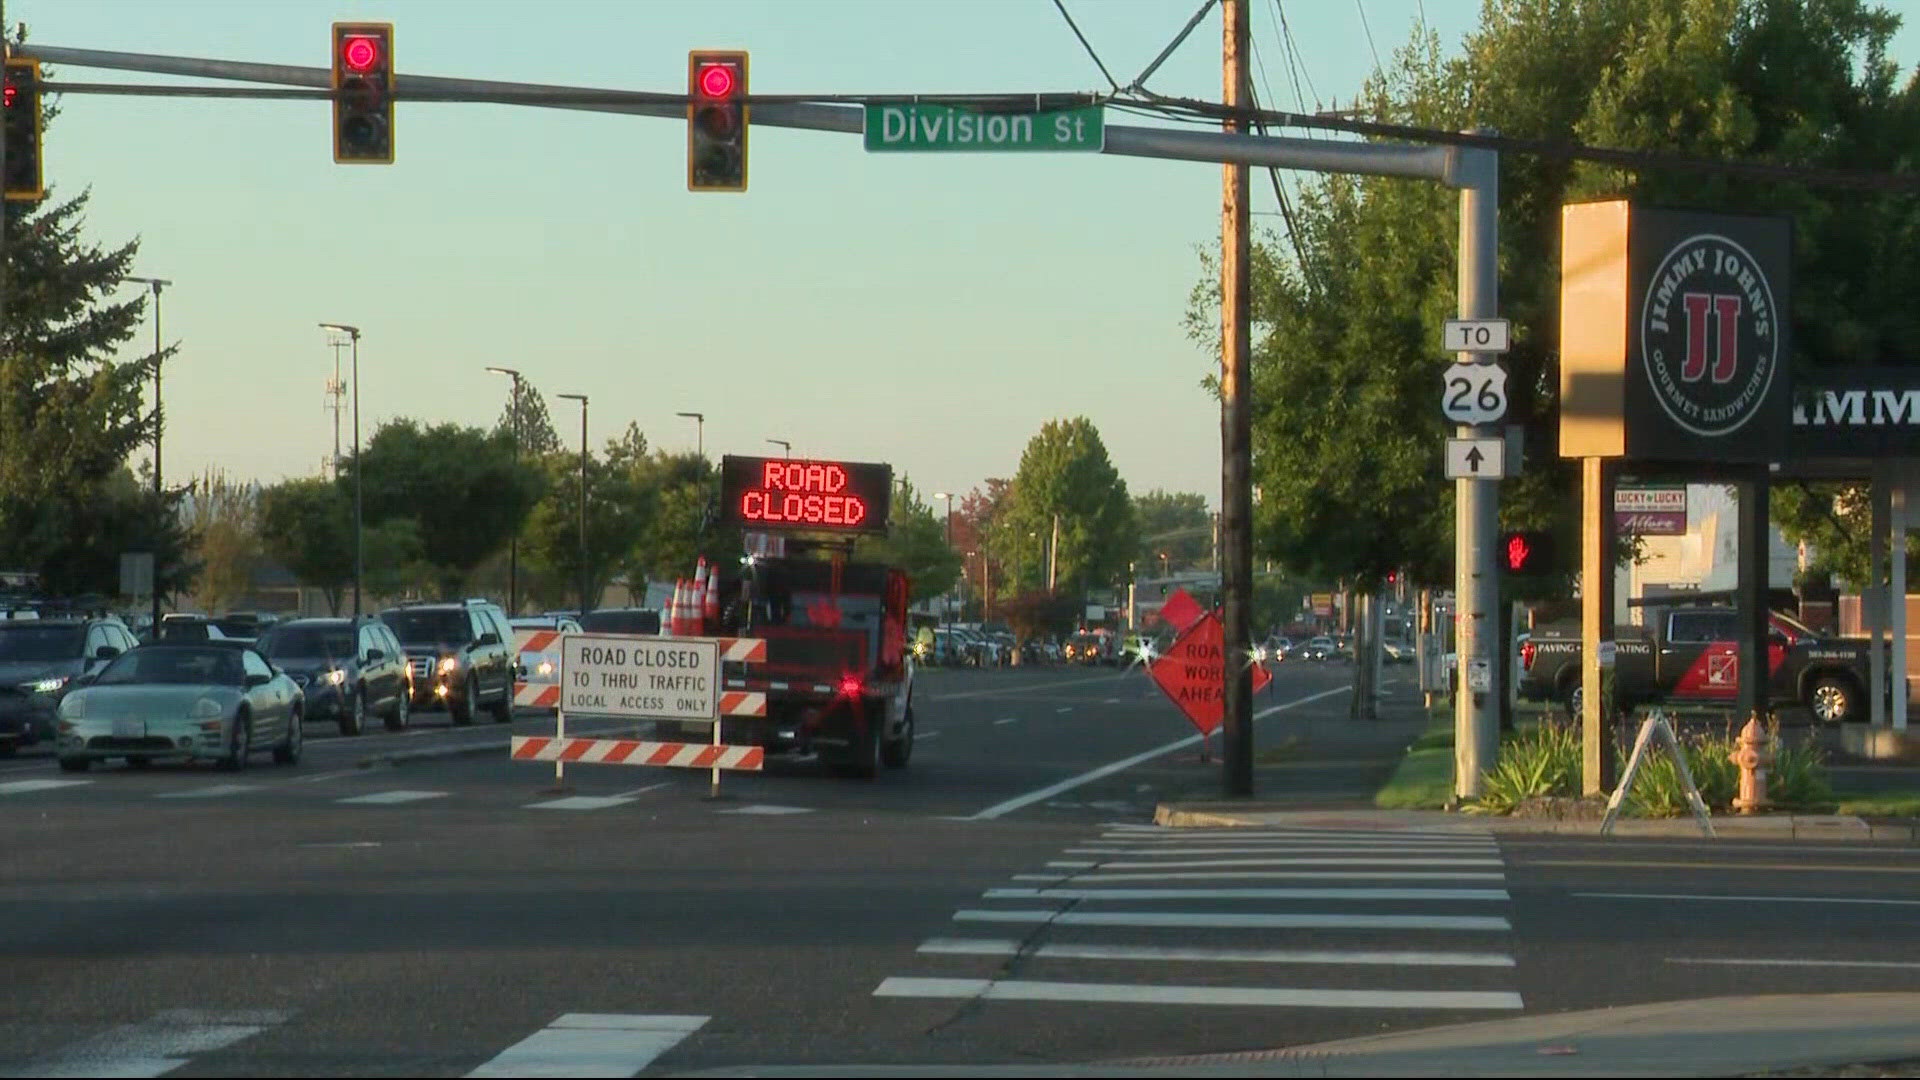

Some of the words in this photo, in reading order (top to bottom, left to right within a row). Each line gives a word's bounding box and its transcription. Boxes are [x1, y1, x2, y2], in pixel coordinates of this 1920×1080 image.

[882, 106, 1032, 143] Division
[1054, 115, 1085, 143] St
[1650, 248, 1706, 334] JIMMY
[1713, 249, 1769, 337] JOHN'S
[1460, 327, 1490, 345] TO
[1681, 292, 1742, 384] JJ
[1448, 377, 1501, 412] 26
[1653, 349, 1700, 418] GOURMET
[1703, 354, 1767, 422] SANDWICHES
[764, 461, 846, 494] ROAD
[742, 490, 865, 525] CLOSED
[1616, 492, 1646, 504] LUCKY
[1653, 492, 1684, 504] LUCKY
[581, 647, 626, 666] ROAD
[634, 648, 700, 669] CLOSED
[1186, 644, 1220, 659] ROA
[1538, 643, 1575, 653] PAVING
[572, 671, 590, 688] TO
[601, 672, 638, 689] THRU
[649, 674, 706, 692] TRAFFIC
[1184, 665, 1222, 681] WOR
[570, 694, 608, 708] LOCAL
[619, 696, 665, 710] ACCESS
[676, 698, 707, 712] ONLY
[1180, 687, 1224, 701] AHEA
